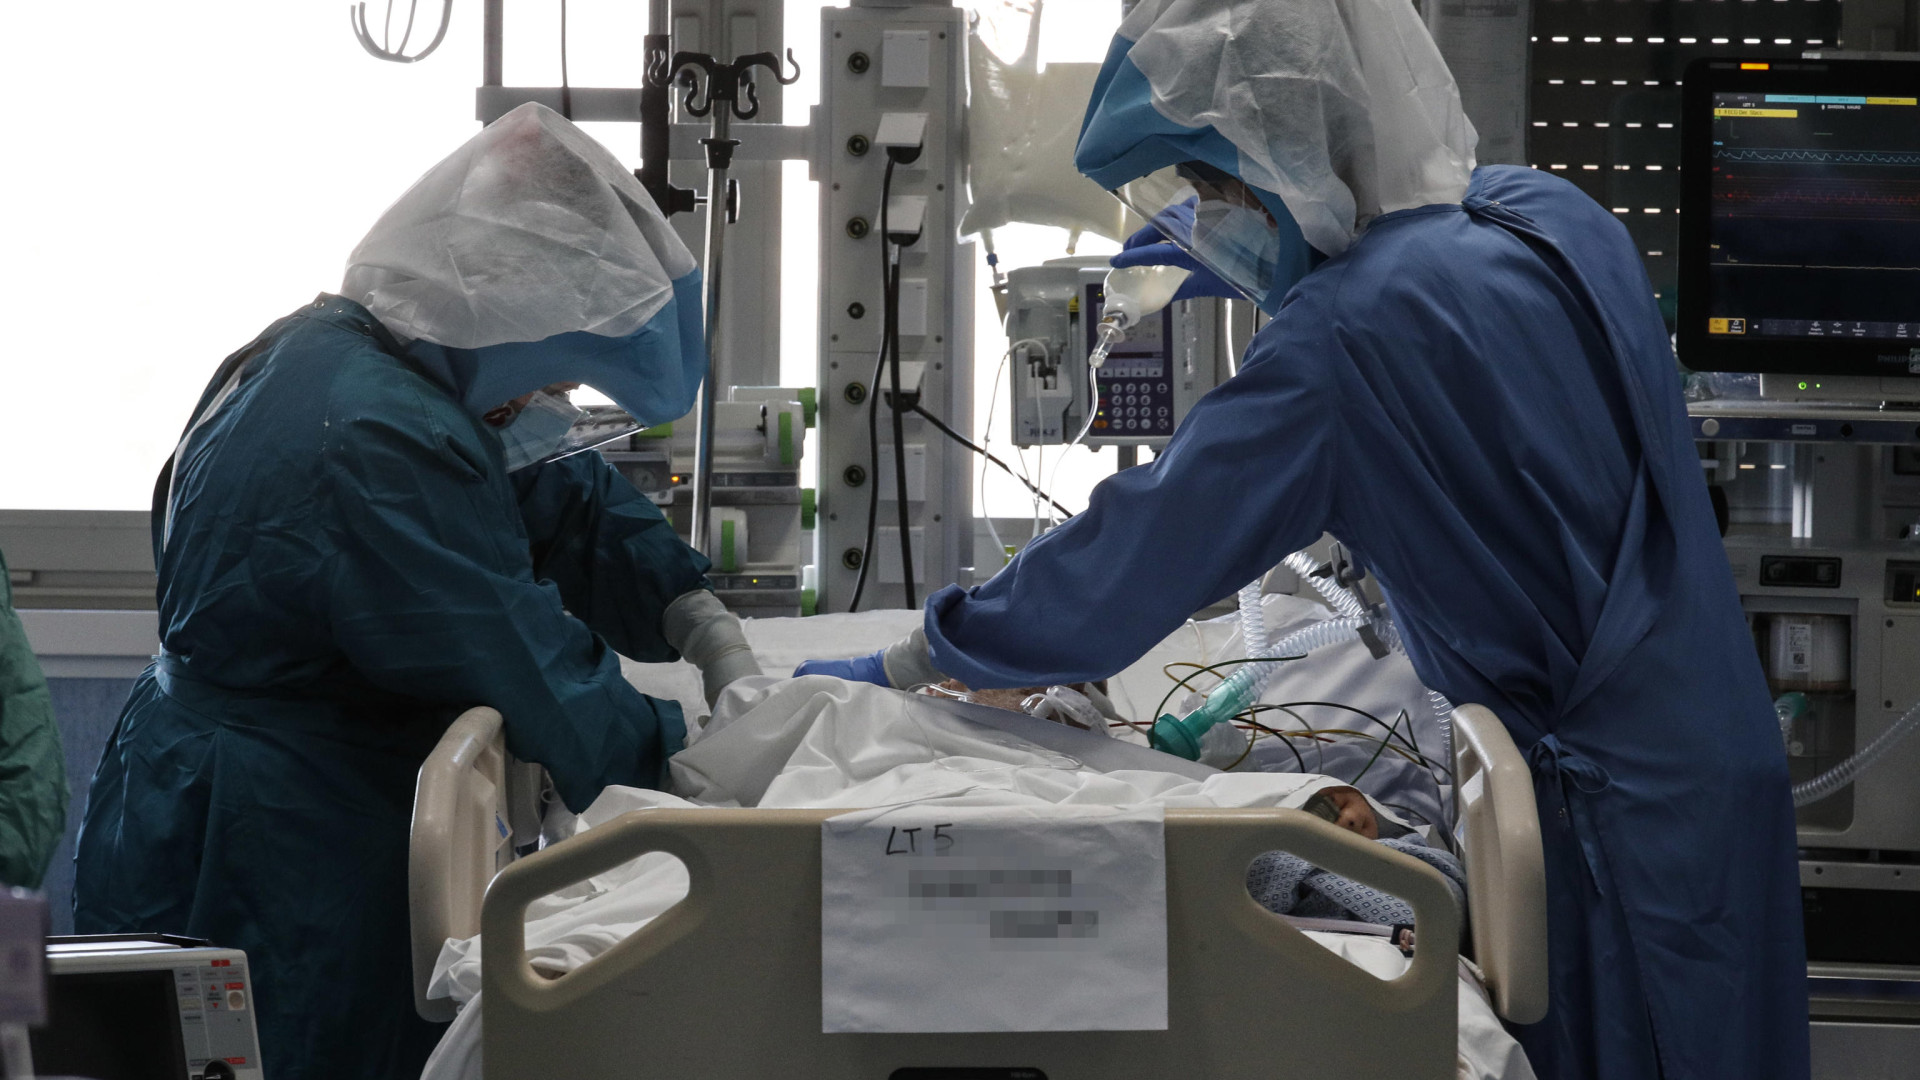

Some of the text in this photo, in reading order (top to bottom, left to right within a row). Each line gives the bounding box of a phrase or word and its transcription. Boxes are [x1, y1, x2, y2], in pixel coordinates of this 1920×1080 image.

[1877, 354, 1910, 363] PHILIP
[886, 823, 954, 855] LT 5
